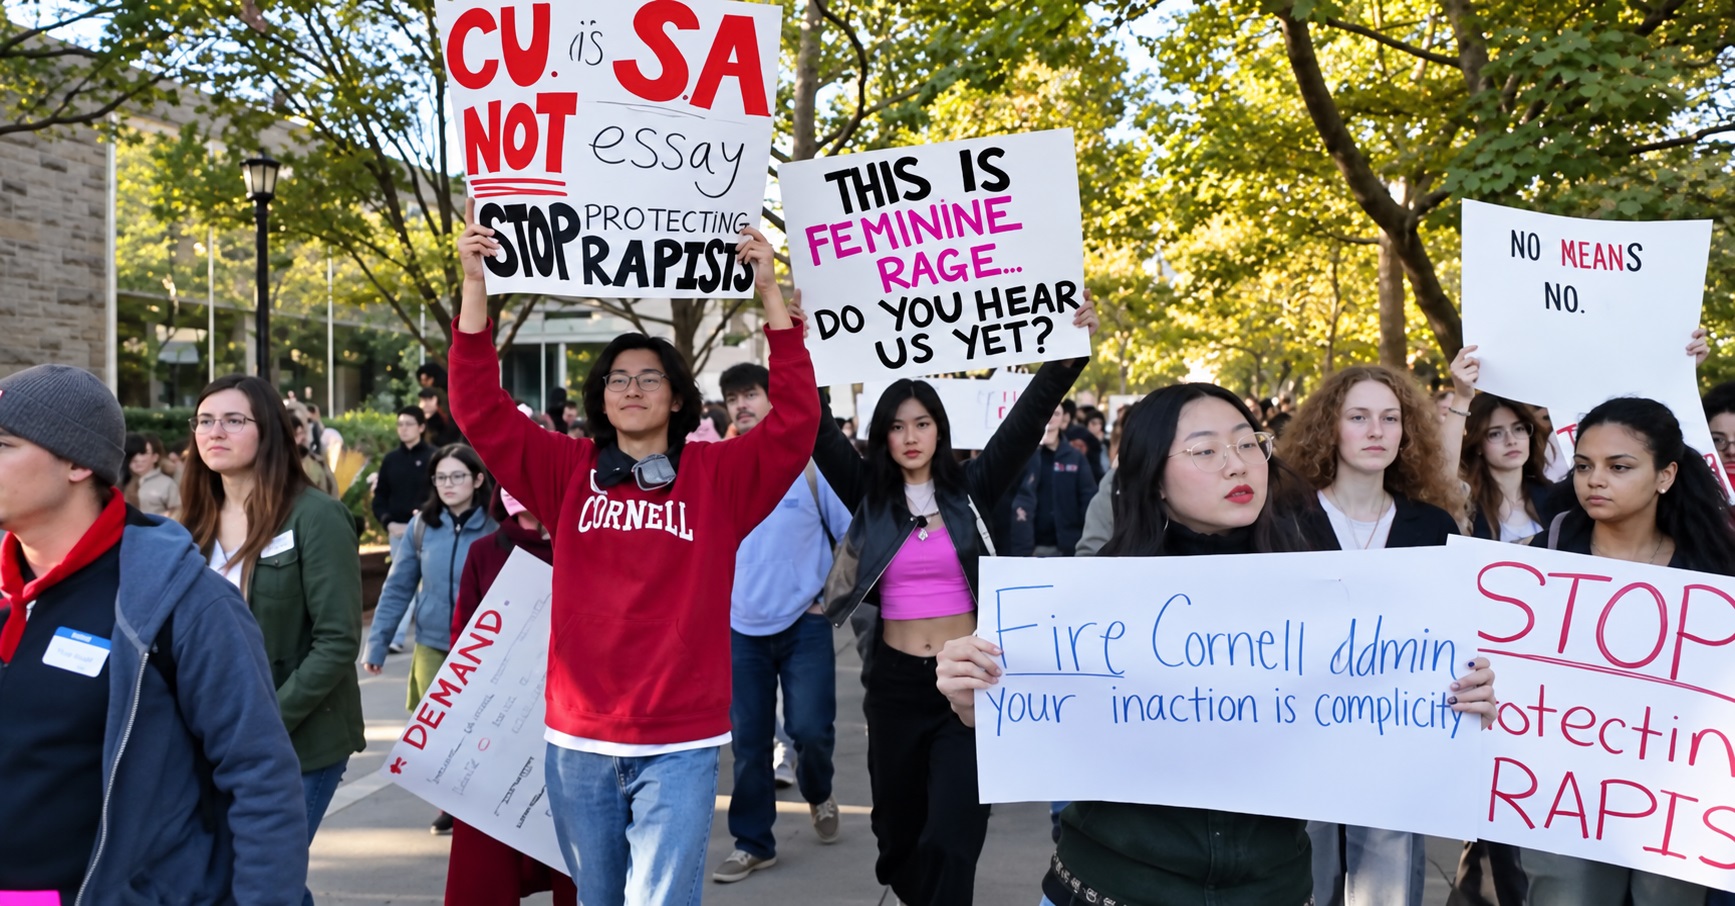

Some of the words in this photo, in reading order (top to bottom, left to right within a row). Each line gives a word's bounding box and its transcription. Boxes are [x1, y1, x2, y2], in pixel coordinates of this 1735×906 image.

[464, 92, 578, 176] NOT
[588, 126, 745, 199] essay
[824, 156, 931, 215] THIS
[959, 147, 1010, 192] IS
[479, 202, 581, 281] STOP
[582, 236, 755, 294] RAPISTS
[1510, 229, 1541, 261] NO
[1561, 239, 1643, 272] MEANS
[814, 305, 865, 340] DO
[877, 291, 963, 331] YOU
[974, 280, 1080, 321] HEAR
[1544, 281, 1586, 314] NO.
[875, 333, 934, 369] US
[952, 316, 1054, 360] YET?
[578, 494, 693, 541] CORNELL
[995, 584, 1126, 675] Fire
[1152, 593, 1304, 676] Cornell
[1477, 561, 1735, 681] STOP
[402, 609, 503, 750] DEMAND
[986, 686, 1077, 737] your
[1112, 686, 1259, 725] inaction
[1275, 688, 1297, 724] is
[1314, 687, 1463, 739] complicity
[1488, 684, 1735, 778] otectin
